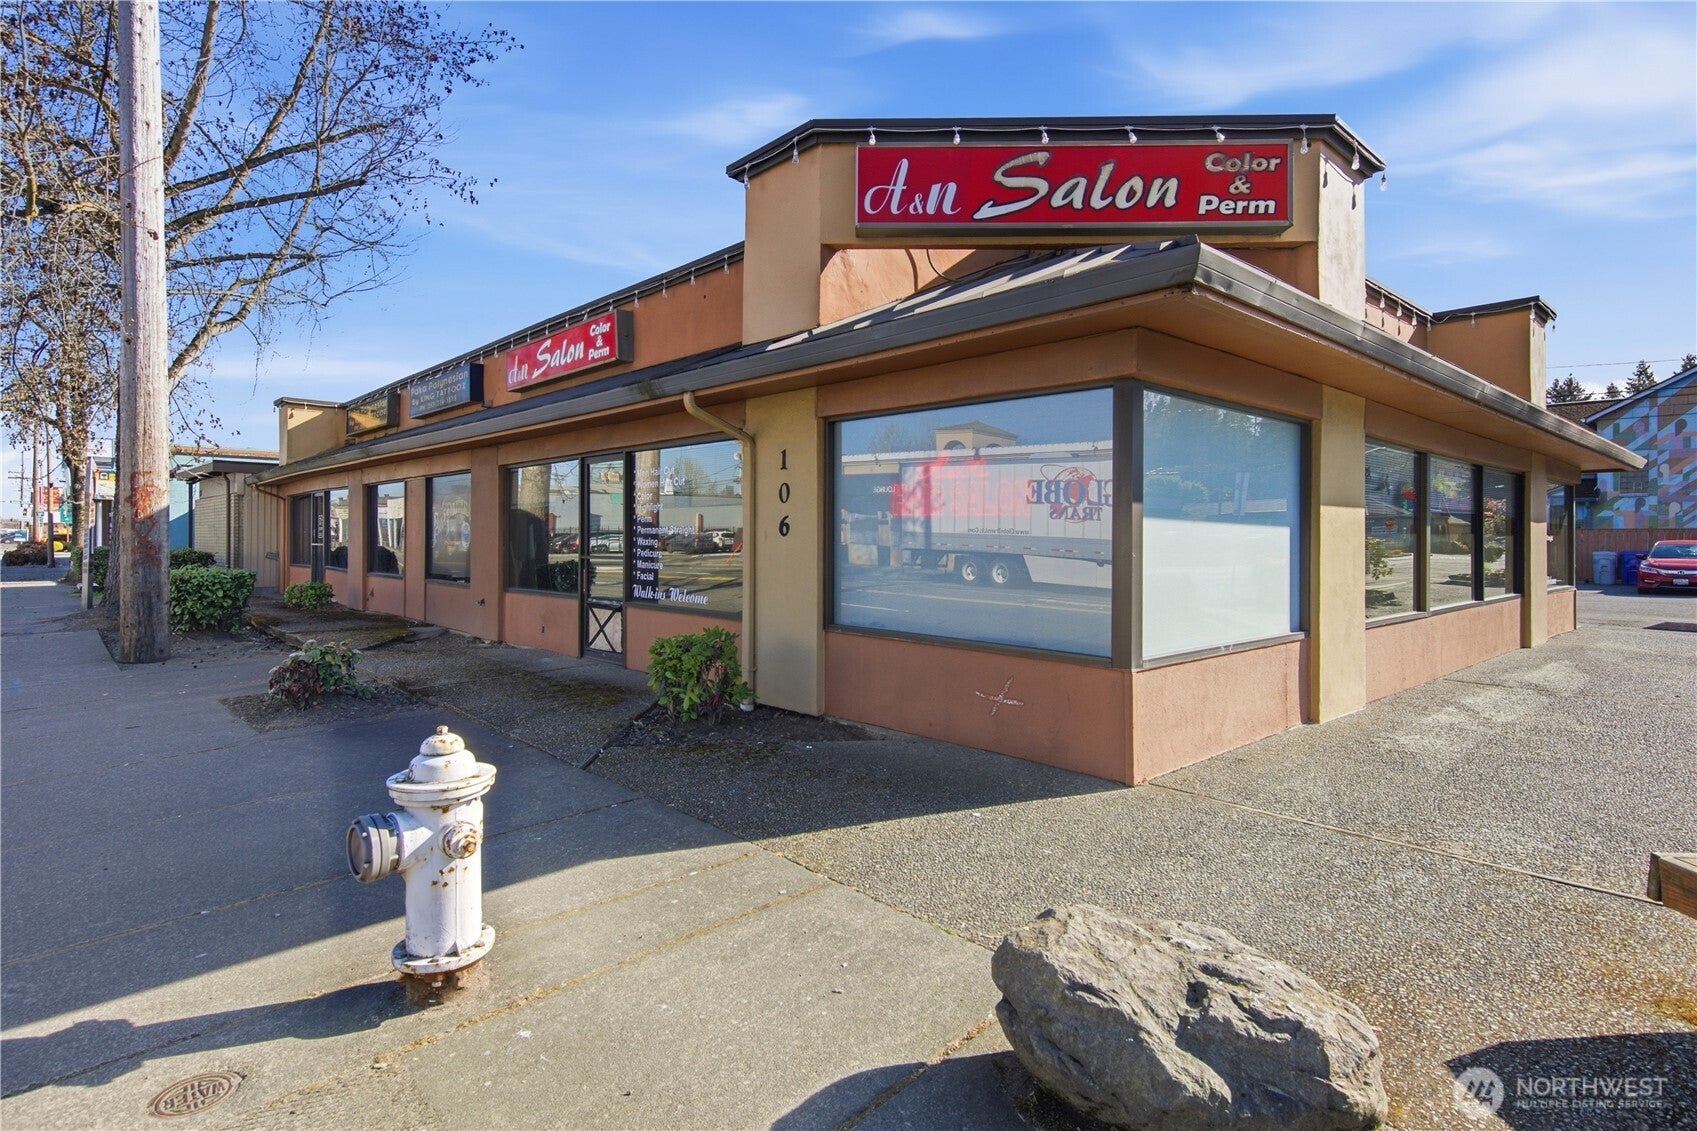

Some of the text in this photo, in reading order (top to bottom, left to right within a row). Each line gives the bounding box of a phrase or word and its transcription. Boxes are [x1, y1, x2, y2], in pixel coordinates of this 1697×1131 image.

[1205, 152, 1281, 173] Color
[973, 151, 1178, 219] Salon
[1229, 174, 1251, 195] &
[1198, 195, 1276, 215] Perm
[589, 322, 611, 337] Color
[532, 338, 584, 379] Salon
[588, 346, 610, 361] Perm
[637, 537, 658, 548] Waxing
[637, 549, 663, 558] Pedicure
[637, 560, 664, 570] Manicure
[637, 571, 654, 580] Facial
[669, 587, 709, 605] Welcome
